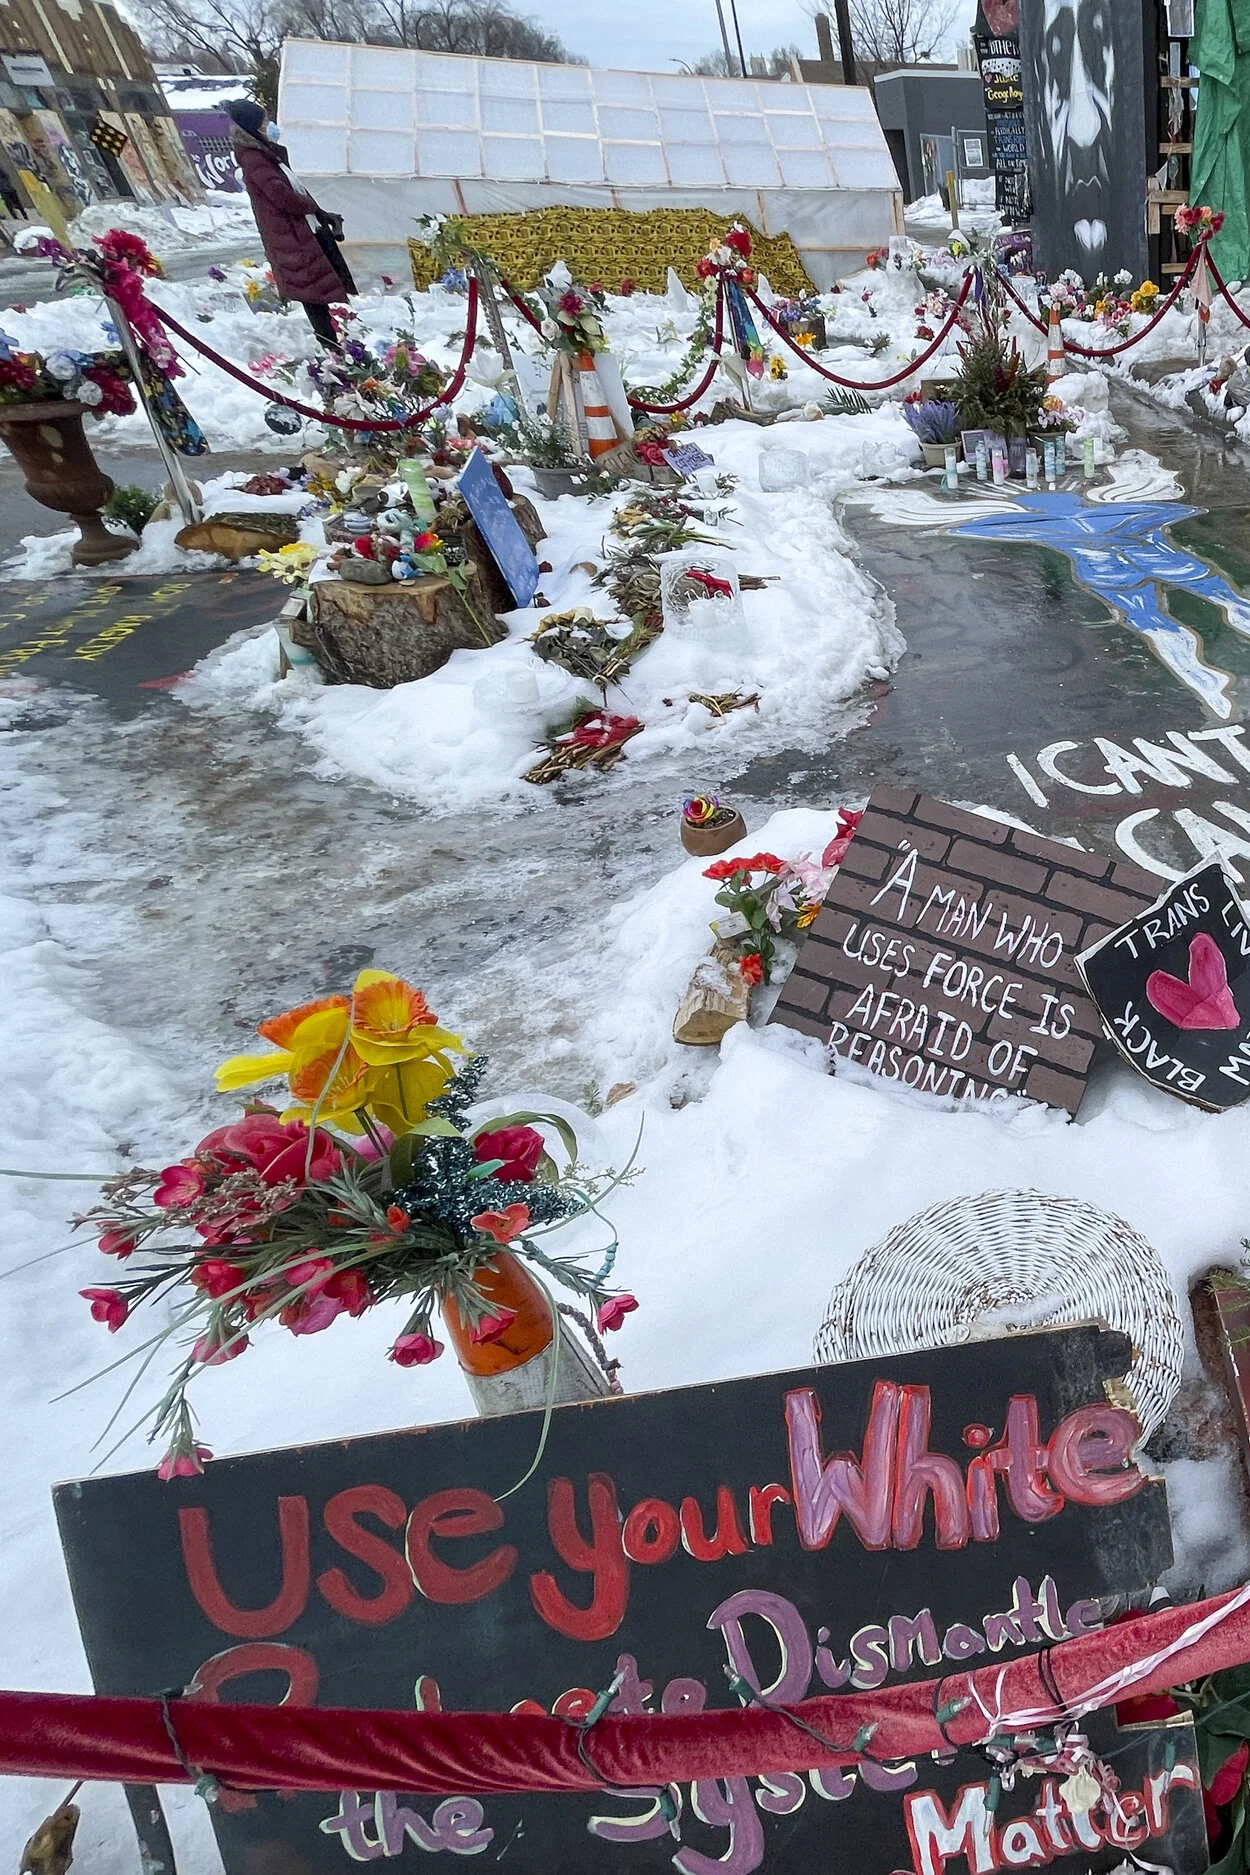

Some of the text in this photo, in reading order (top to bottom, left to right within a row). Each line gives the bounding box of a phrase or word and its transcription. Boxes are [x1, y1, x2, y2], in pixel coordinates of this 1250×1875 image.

[1006, 752, 1049, 808] I
[915, 883, 985, 940] MAN
[992, 910, 1064, 969] WHO
[1114, 882, 1211, 959] TRANS
[842, 923, 1076, 1041] USES FORCE IS
[846, 983, 1039, 1088] AFRAID OF
[1114, 1000, 1207, 1093] BLACK
[528, 1471, 794, 1643] your
[782, 1379, 1149, 1553] White
[318, 1790, 496, 1862] the
